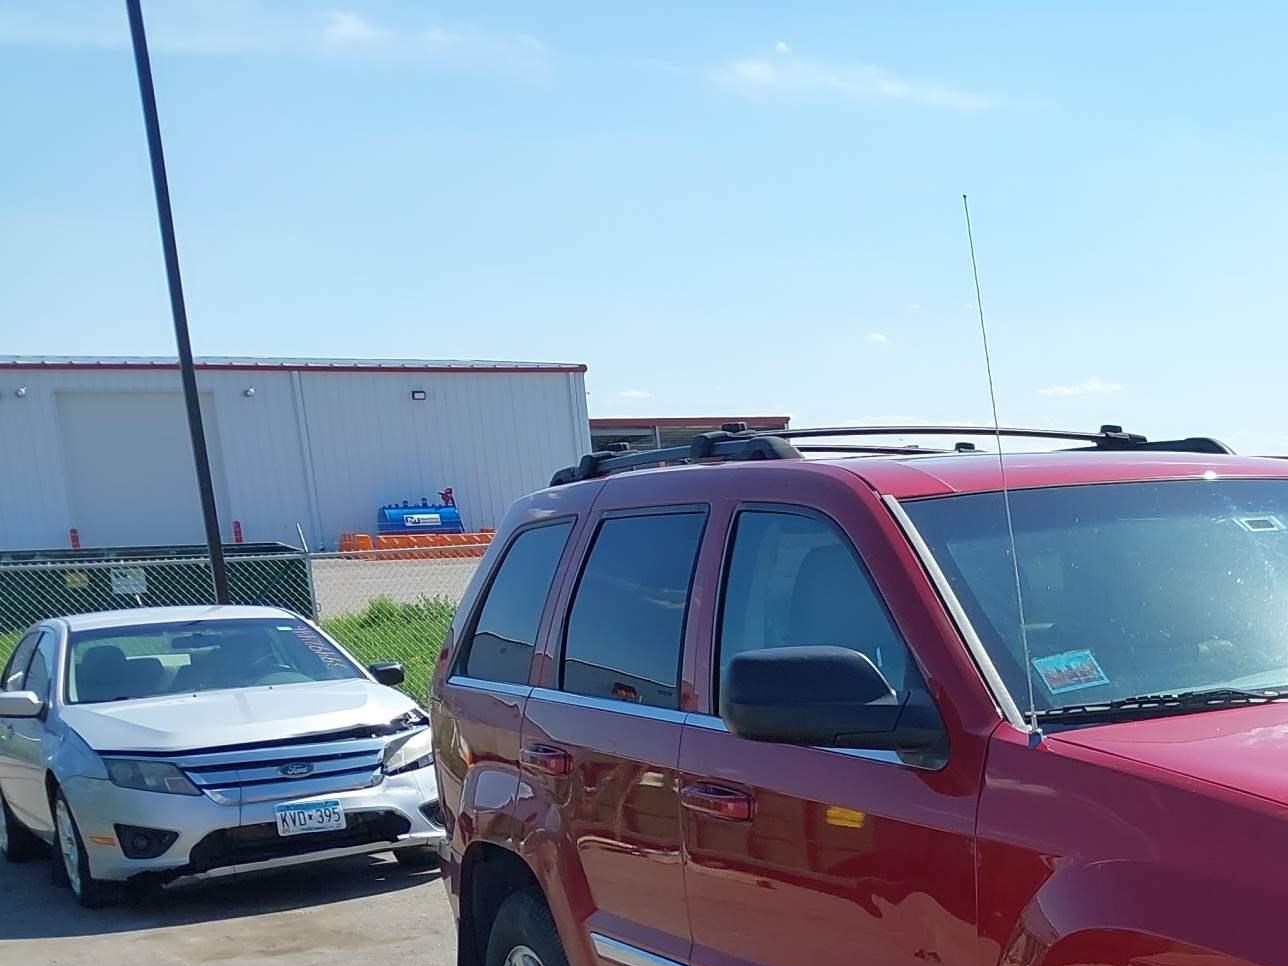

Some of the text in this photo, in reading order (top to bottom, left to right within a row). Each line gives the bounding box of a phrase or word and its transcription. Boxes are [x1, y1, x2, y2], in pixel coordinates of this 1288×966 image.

[286, 763, 309, 776] Ford
[279, 810, 307, 829] KVD
[315, 807, 341, 824] 395
